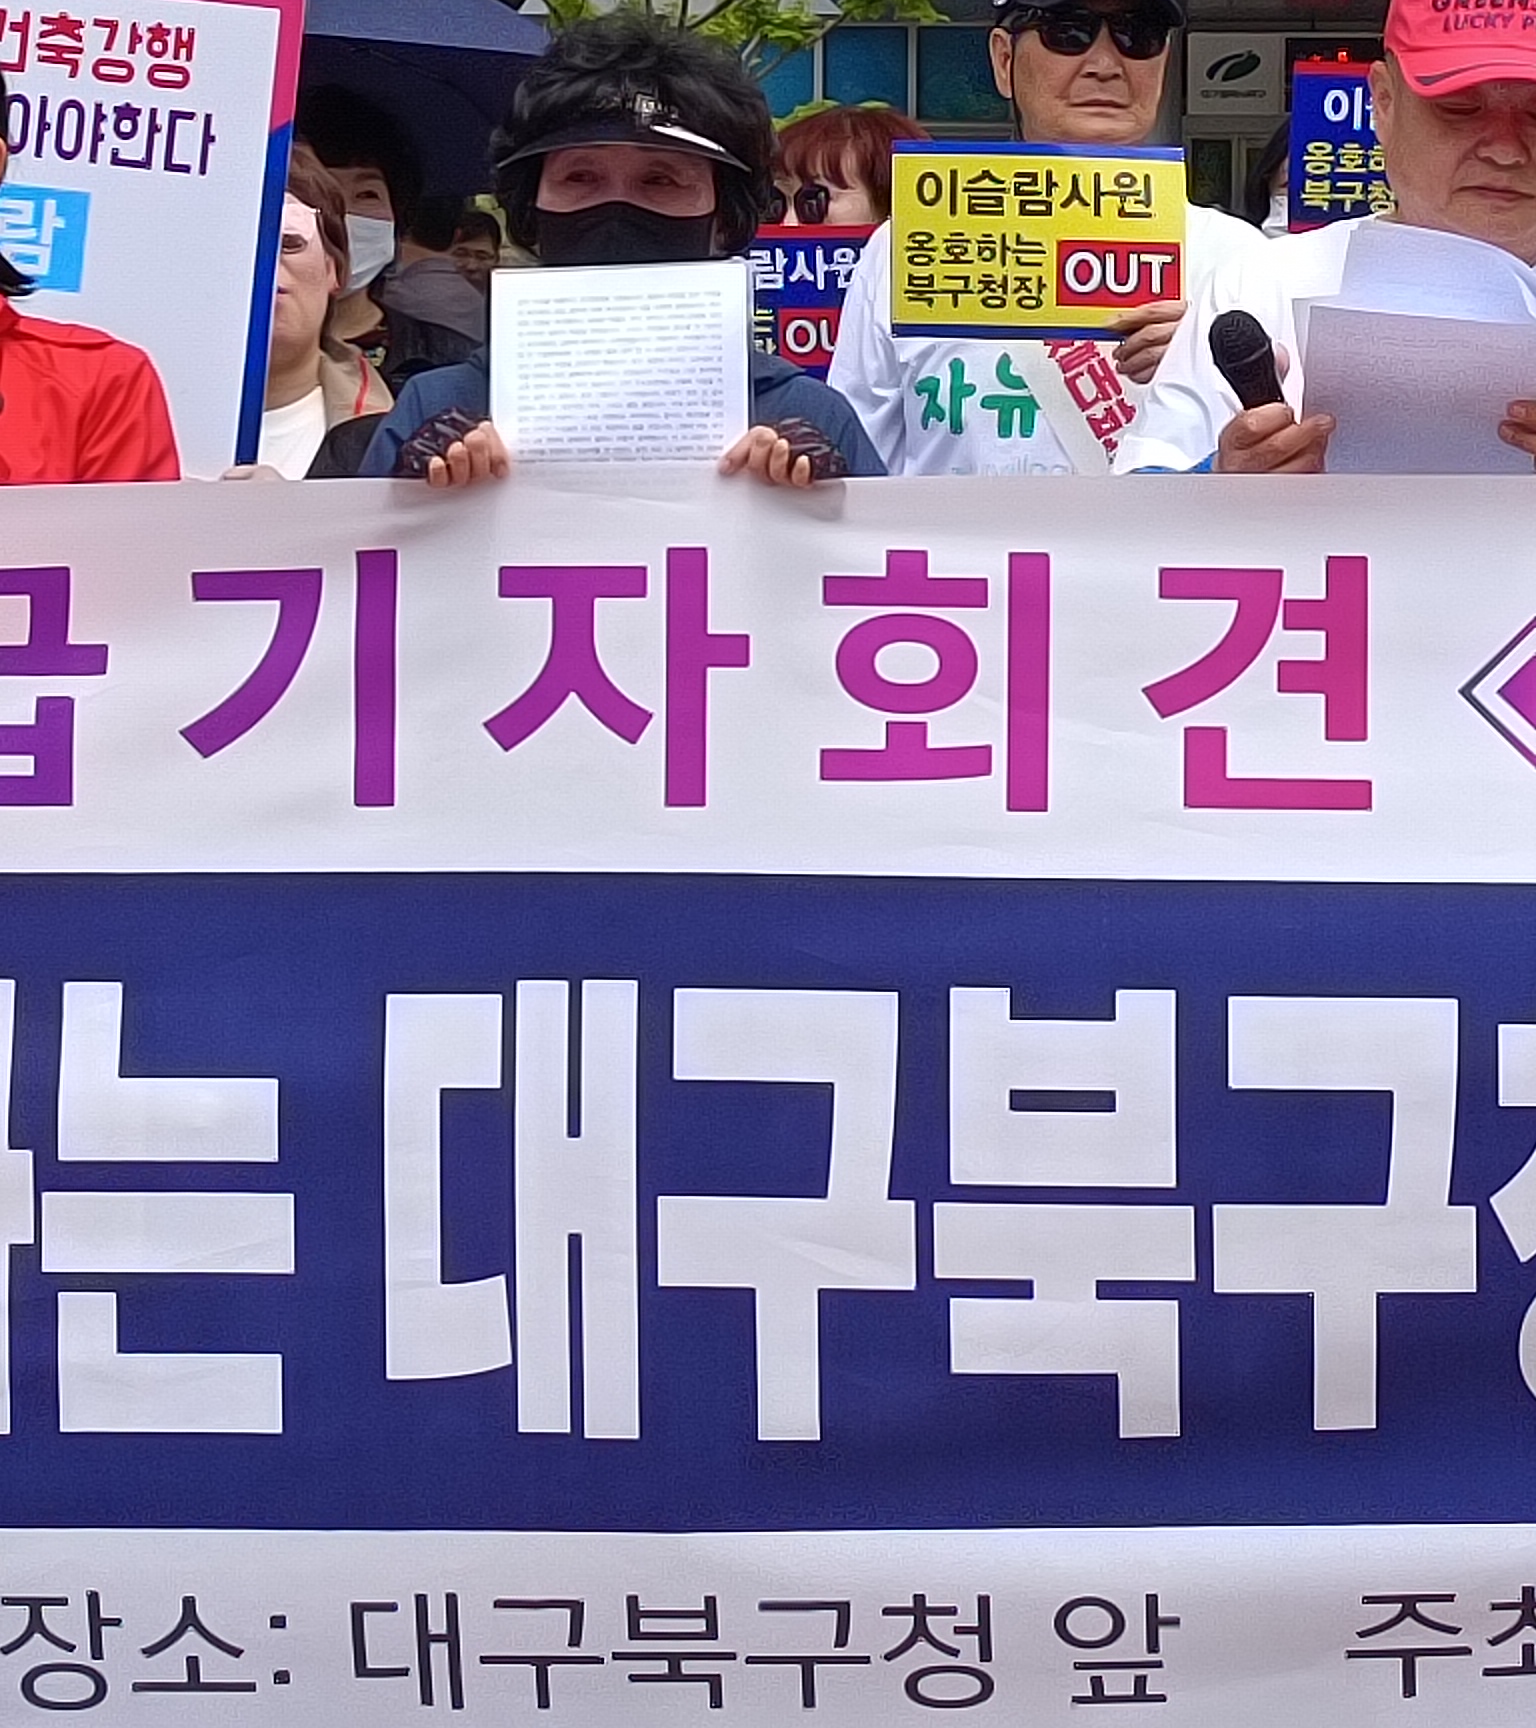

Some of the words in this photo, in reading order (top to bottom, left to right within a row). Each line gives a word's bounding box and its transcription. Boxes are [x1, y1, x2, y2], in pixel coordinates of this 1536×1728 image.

[1443, 12, 1513, 32] LUCKY
[915, 168, 1154, 218] 이슬람사원
[905, 230, 1047, 268] 옹호하는
[904, 273, 1047, 310] 북구청장
[1065, 250, 1174, 295] OUT
[348, 1591, 998, 1711] 대구북구청
[1051, 1592, 1182, 1706] 앞
